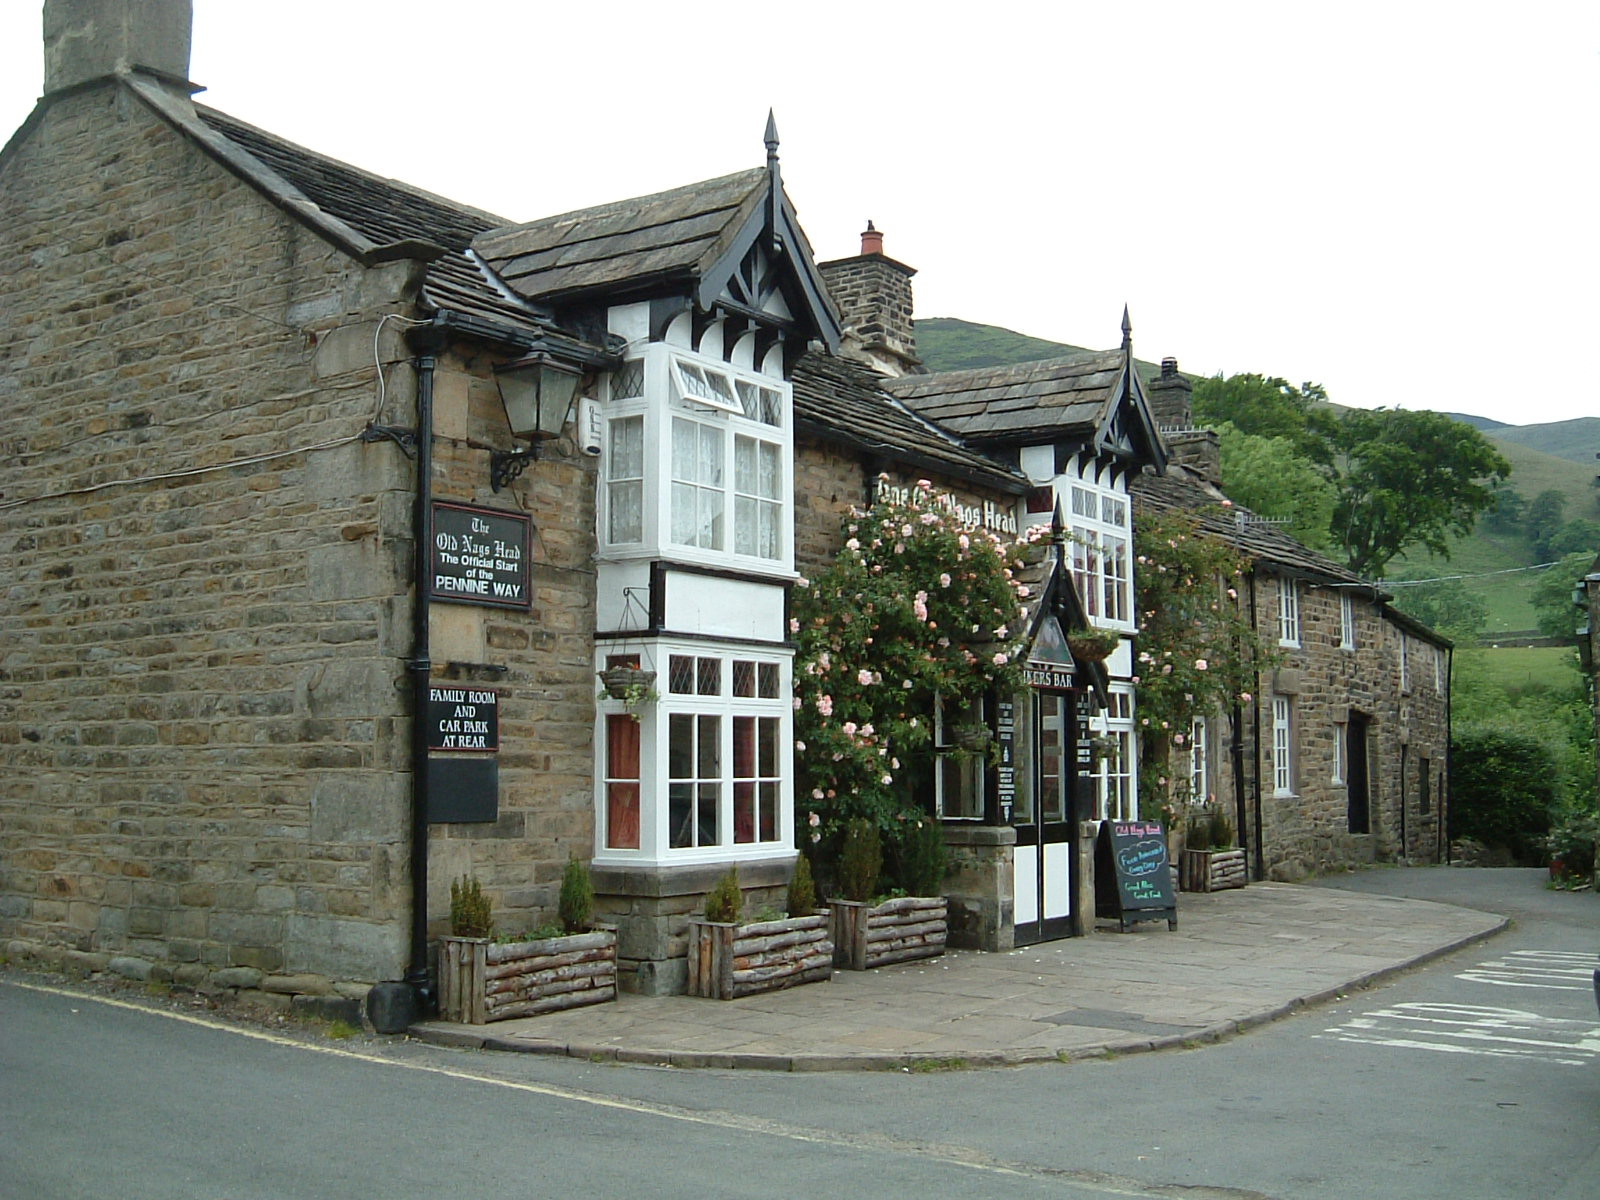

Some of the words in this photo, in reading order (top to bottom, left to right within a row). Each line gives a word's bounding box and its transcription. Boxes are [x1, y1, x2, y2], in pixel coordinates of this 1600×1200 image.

[471, 517, 490, 535] The
[983, 500, 1018, 534] Head
[436, 532, 458, 551] Old
[462, 534, 490, 557] Nags
[493, 540, 521, 560] Head
[440, 552, 459, 564] The
[461, 555, 494, 568] Official
[495, 560, 518, 573] Start
[466, 568, 477, 578] of
[478, 569, 494, 580] the
[435, 575, 489, 595] PENNINE
[493, 581, 521, 598] WAY
[1023, 670, 1052, 686] IKERS
[1053, 673, 1073, 688] BAR
[430, 689, 466, 703] FAMILY
[468, 691, 496, 704] ROOM
[454, 705, 476, 718] AND
[439, 719, 461, 732] CAR
[463, 721, 489, 733] PARK
[442, 735, 456, 748] AT
[458, 735, 486, 748] REAR
